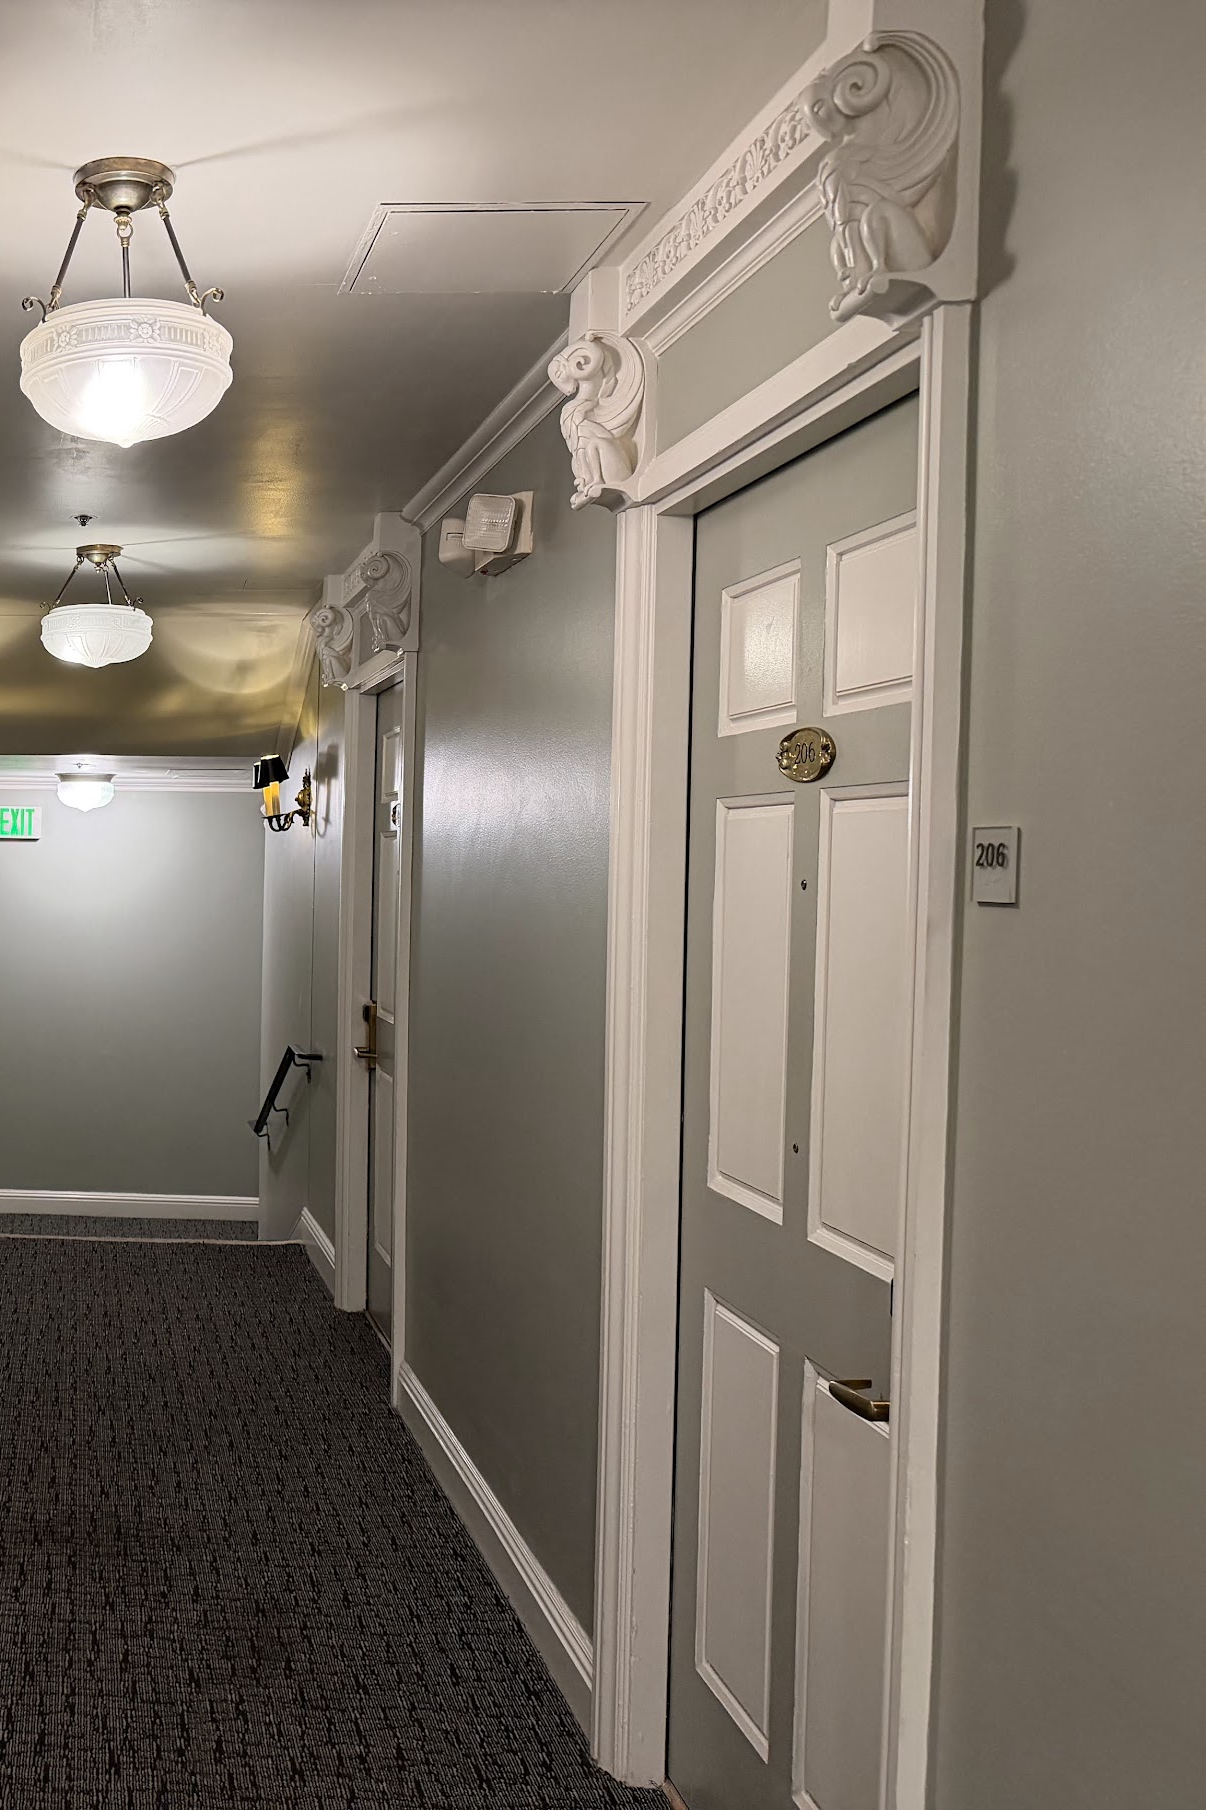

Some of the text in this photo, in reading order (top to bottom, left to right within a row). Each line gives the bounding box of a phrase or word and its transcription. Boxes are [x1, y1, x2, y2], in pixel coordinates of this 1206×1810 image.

[794, 742, 816, 764] 206
[0, 808, 35, 836] EXIT
[975, 842, 1006, 867] 206
